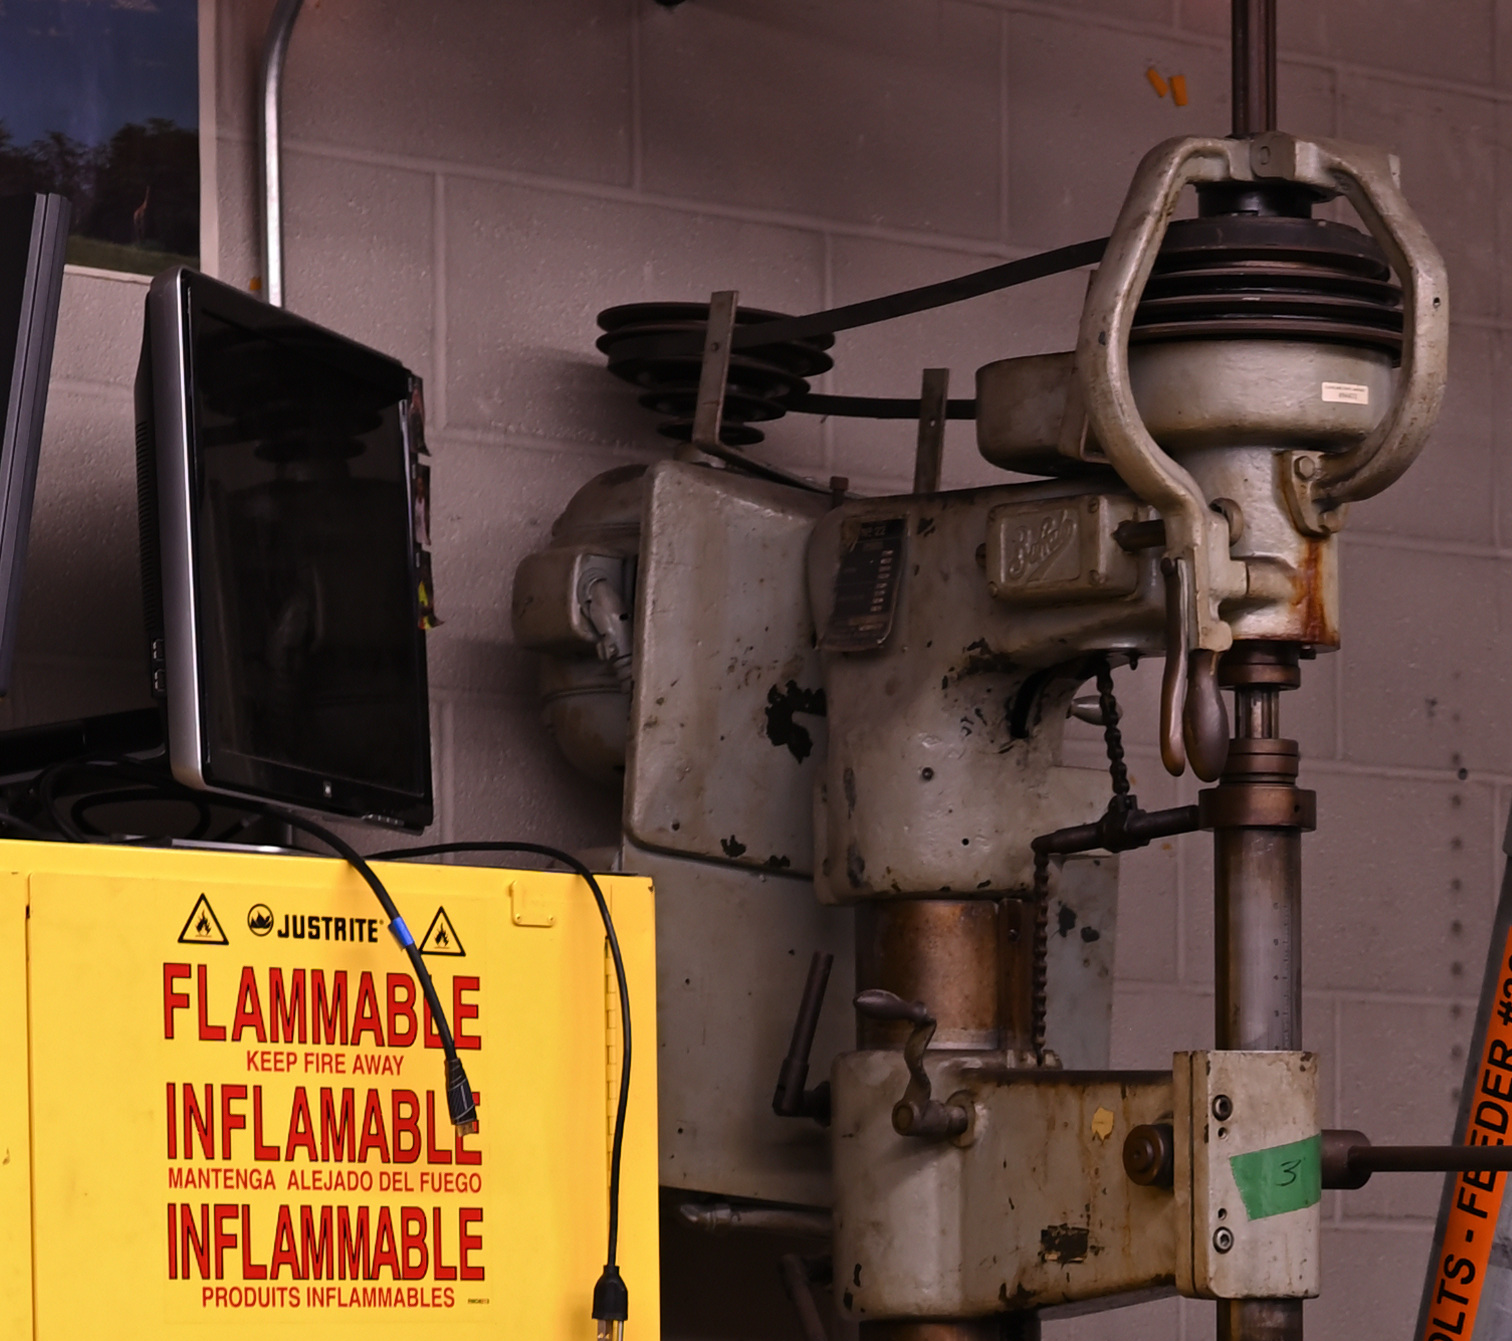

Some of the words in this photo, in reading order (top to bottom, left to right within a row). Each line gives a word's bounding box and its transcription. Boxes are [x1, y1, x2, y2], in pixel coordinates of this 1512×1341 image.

[277, 914, 379, 943] JUSTRITE
[163, 962, 482, 1051] FLAMMABLE
[246, 1050, 297, 1073] KEEP
[304, 1052, 346, 1075] FIRE
[352, 1054, 404, 1076] AWAY
[166, 1082, 483, 1166] INFLAMABLE
[168, 1167, 276, 1190] MANTENGA
[287, 1169, 373, 1192] ALEJADO
[379, 1171, 414, 1193] DEL
[420, 1172, 482, 1194] FUEGO
[1275, 1159, 1302, 1187] 3
[167, 1203, 485, 1281] INFLAMMABLE
[202, 1286, 301, 1308] PRODUITS
[307, 1286, 455, 1309] INFLAMMABLES
